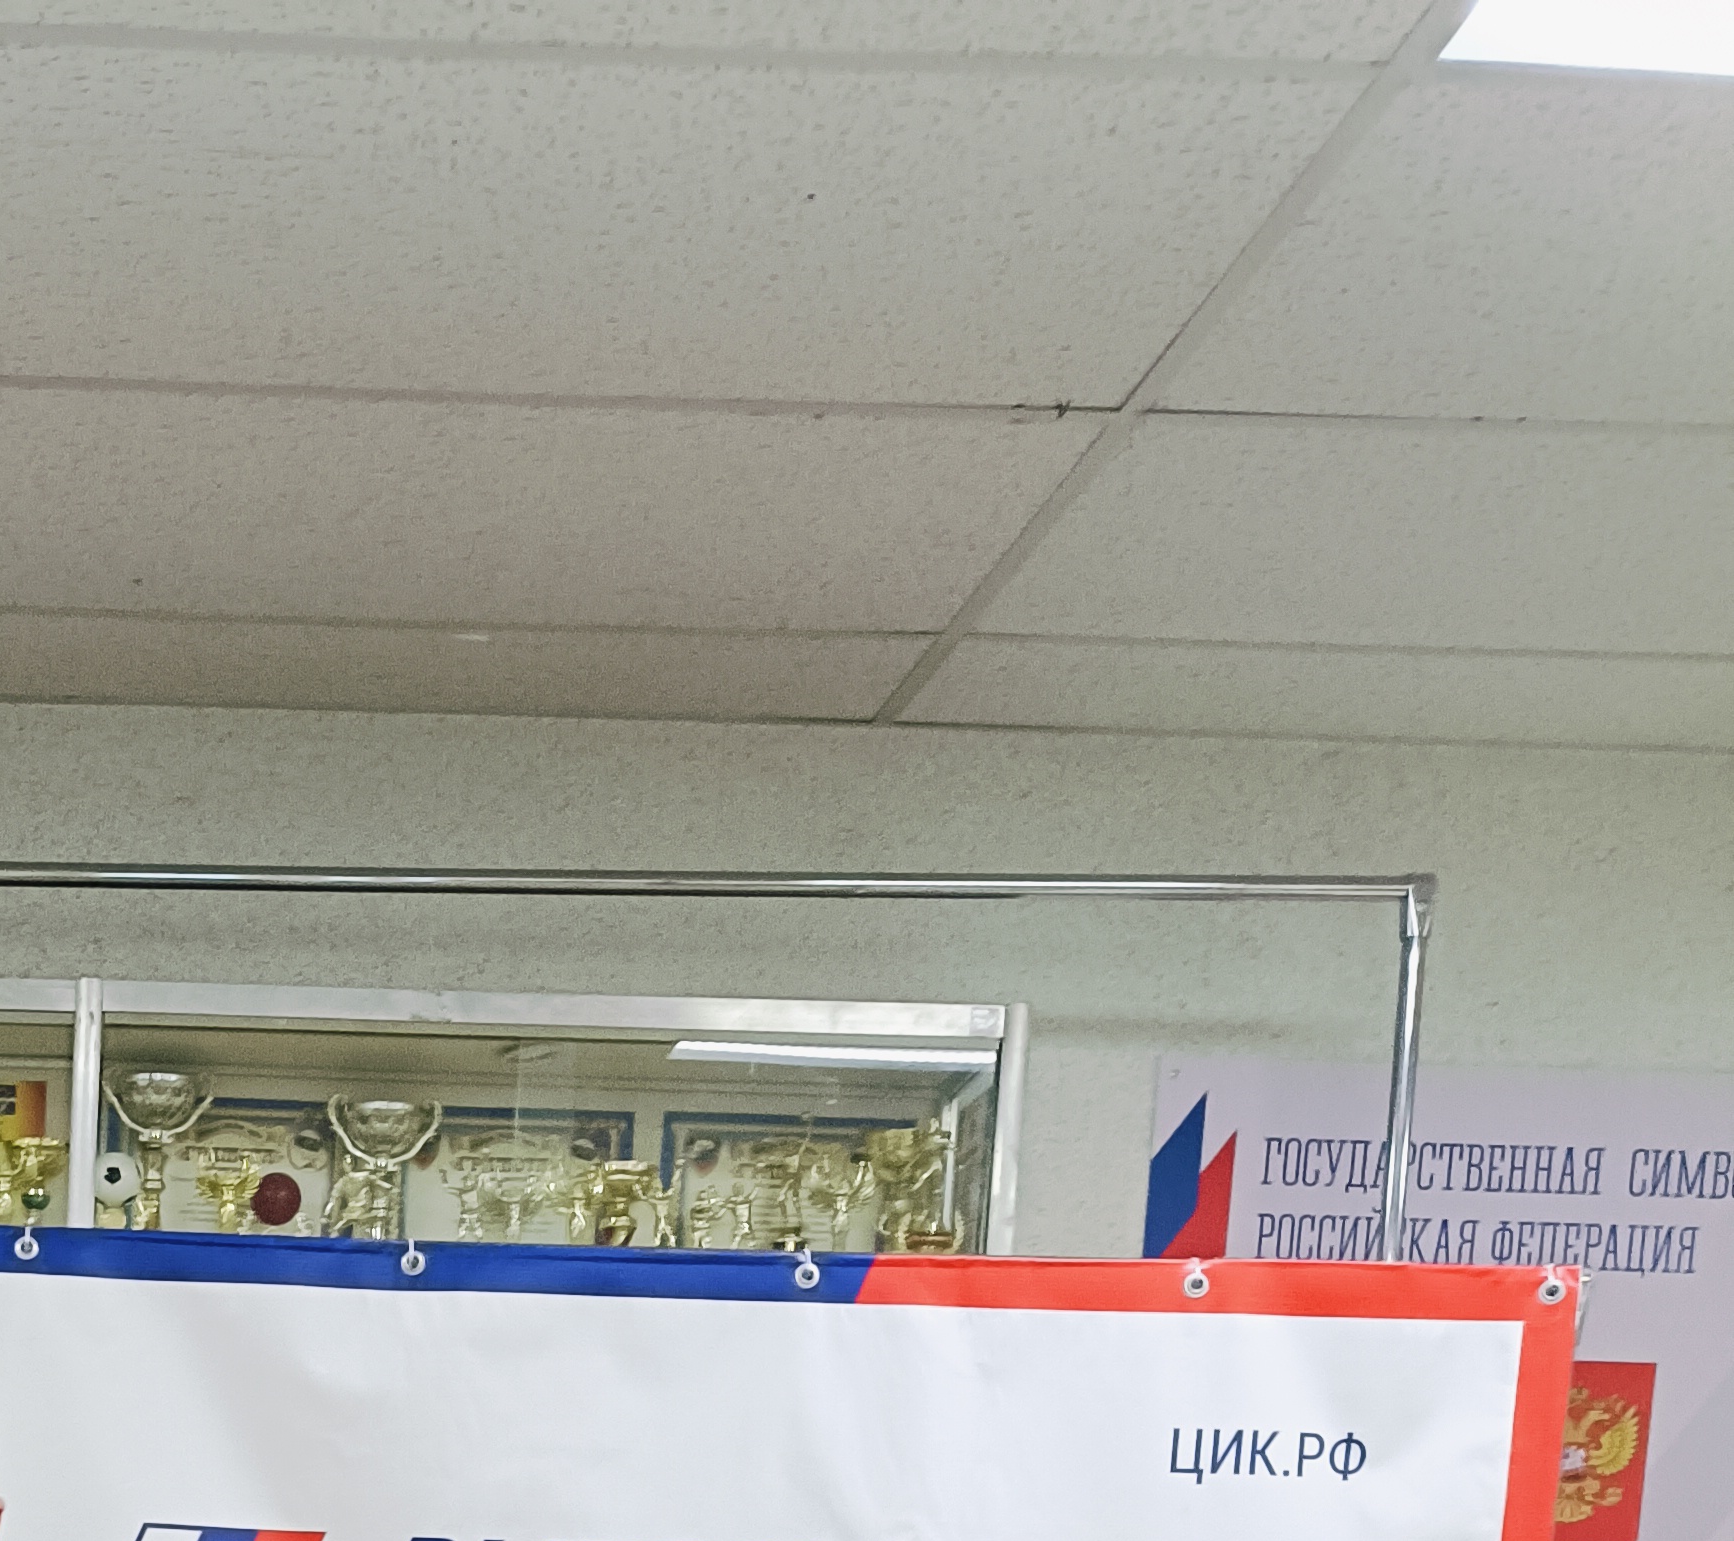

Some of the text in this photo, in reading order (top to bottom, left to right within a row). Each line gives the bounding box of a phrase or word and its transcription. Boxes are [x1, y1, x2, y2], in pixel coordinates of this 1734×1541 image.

[1628, 1148, 1734, 1200] СИМВ
[1254, 1208, 1479, 1265] РОССИЙКАЯ
[1169, 1427, 1367, 1485] ЦИК.РФ
